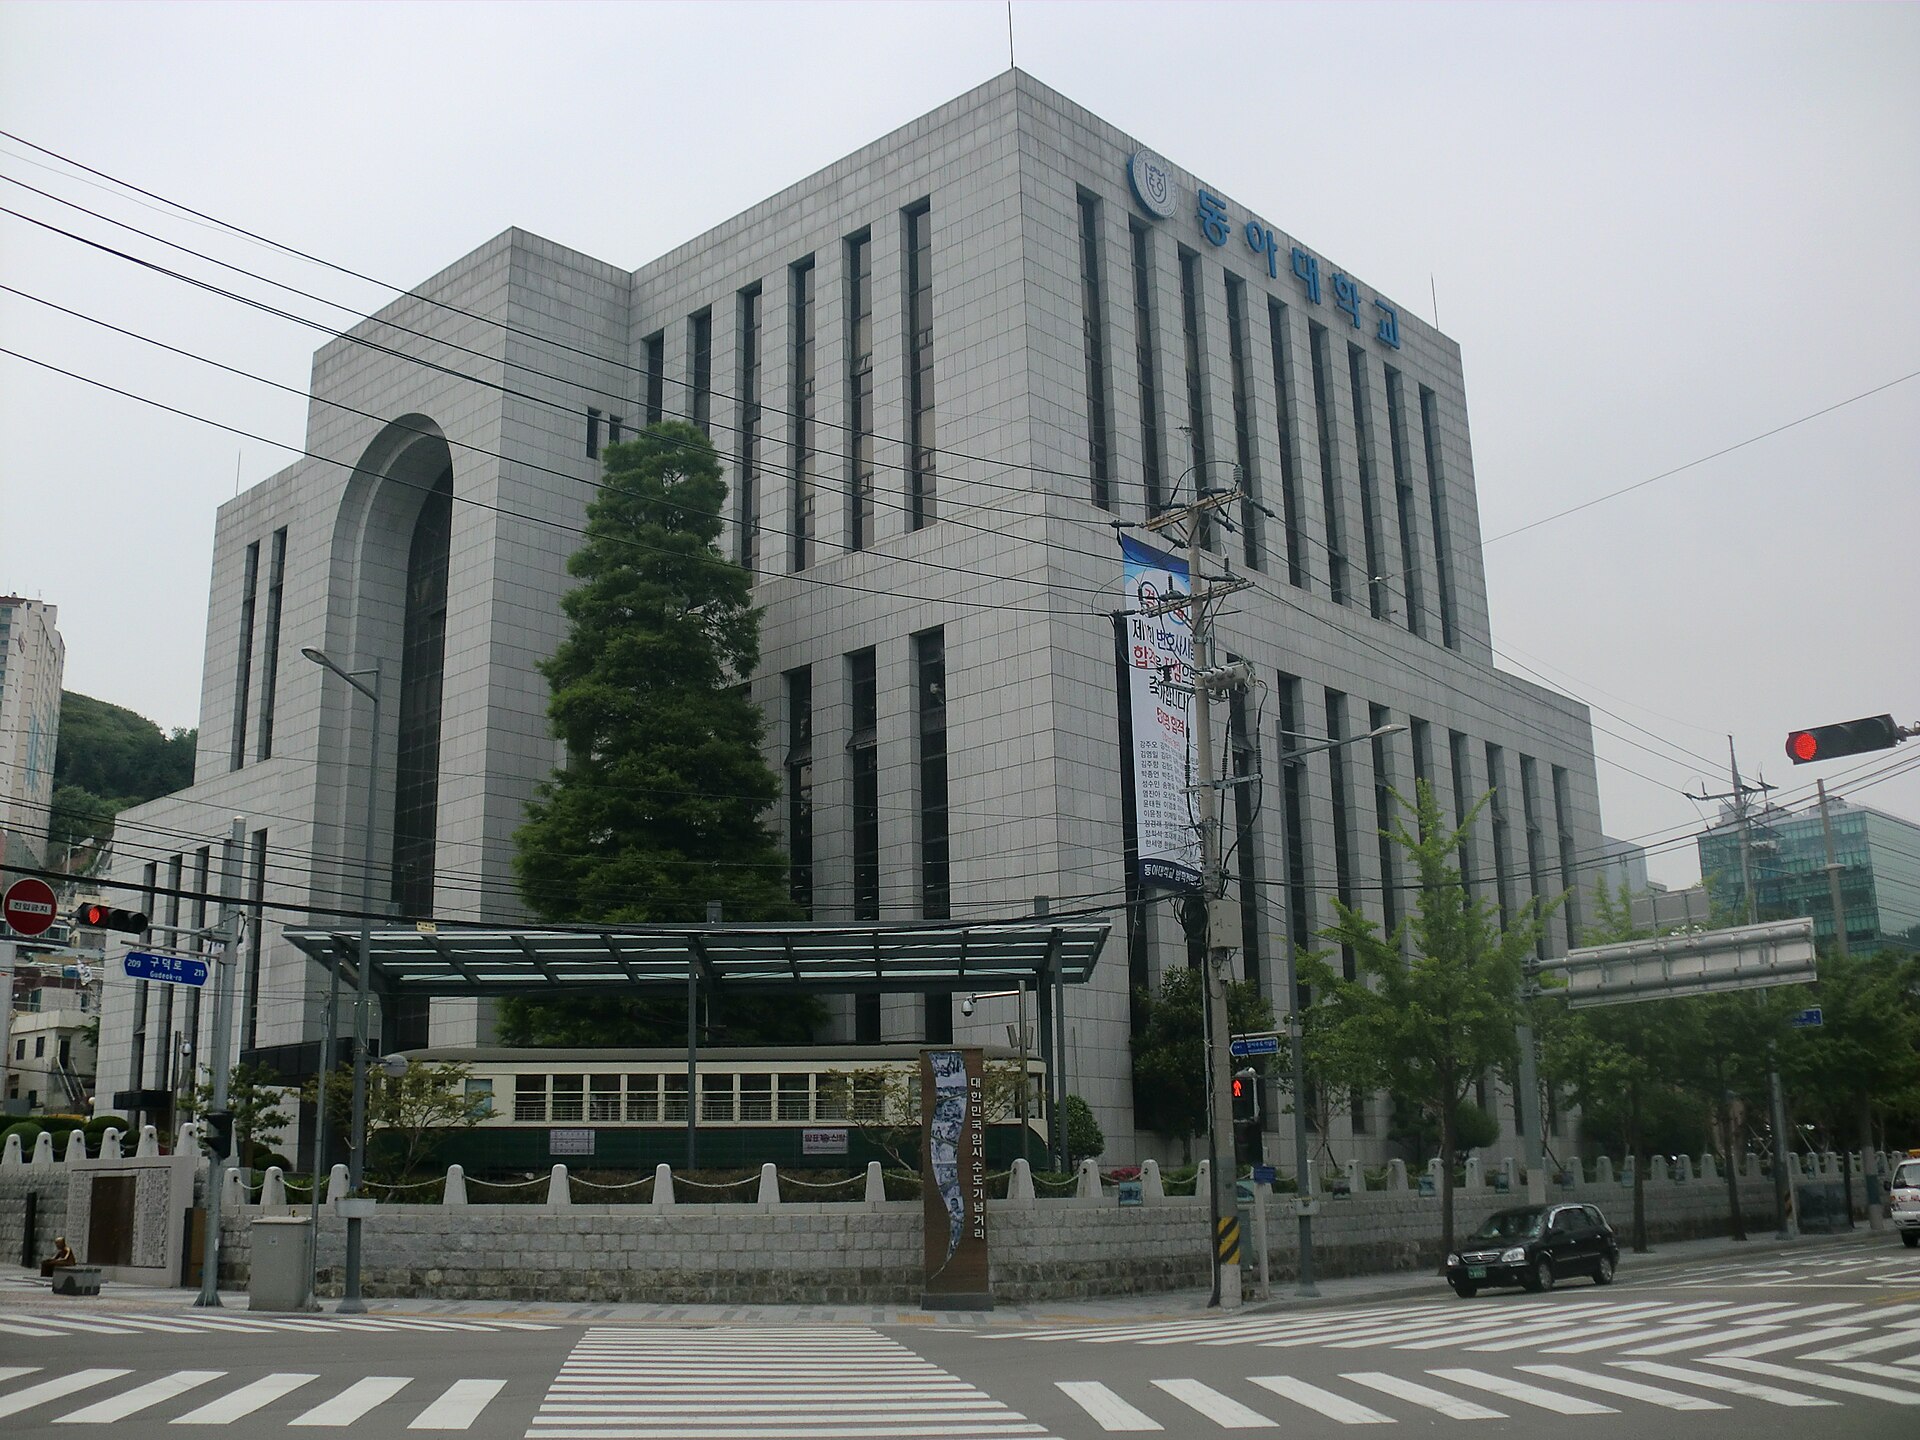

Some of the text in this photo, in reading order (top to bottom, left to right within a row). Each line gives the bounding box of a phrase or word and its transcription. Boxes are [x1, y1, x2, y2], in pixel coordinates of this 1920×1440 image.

[1198, 189, 1401, 349] 동아대학교
[14, 902, 48, 913] 진입금지
[127, 956, 205, 977] 209 구덕로 211
[149, 970, 182, 981] Gudeok-ro
